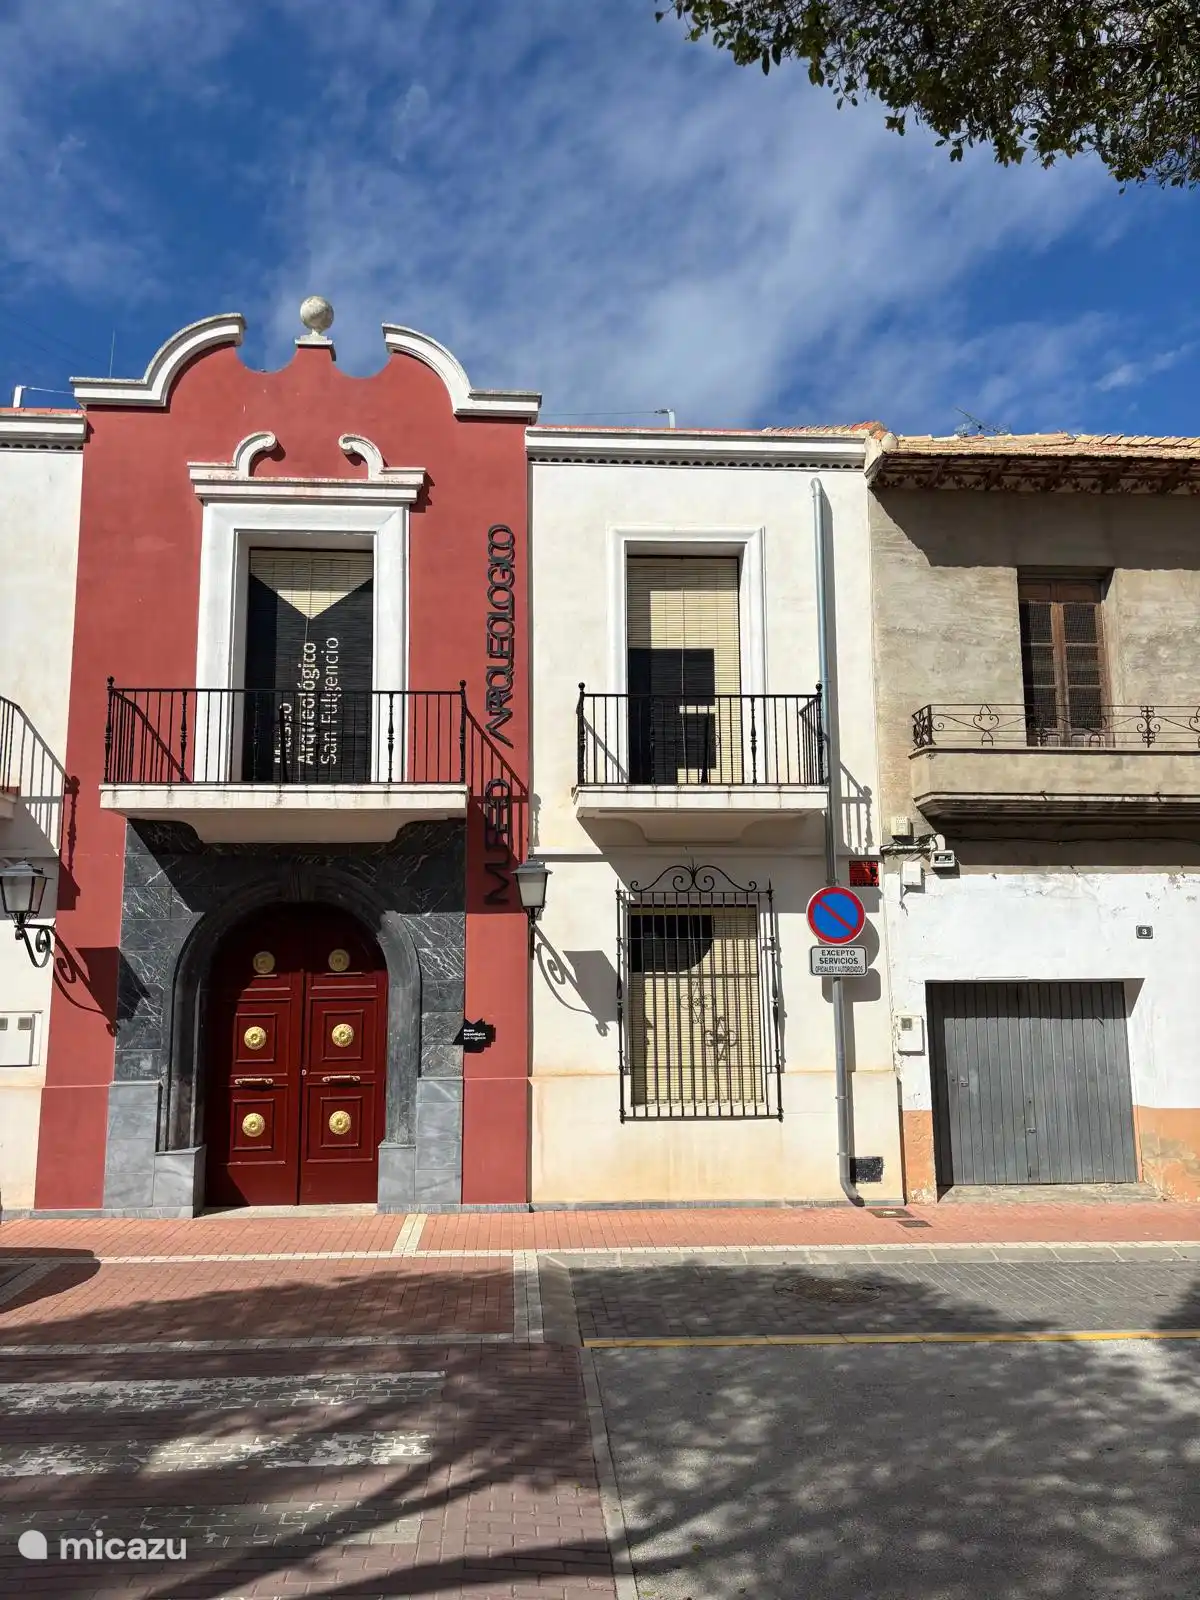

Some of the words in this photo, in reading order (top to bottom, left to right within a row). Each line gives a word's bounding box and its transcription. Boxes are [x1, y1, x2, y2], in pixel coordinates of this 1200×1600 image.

[297, 642, 320, 765] Arqueológico
[320, 637, 342, 724] Fulgencio
[320, 732, 337, 765] San
[819, 957, 859, 965] SERVICIOS
